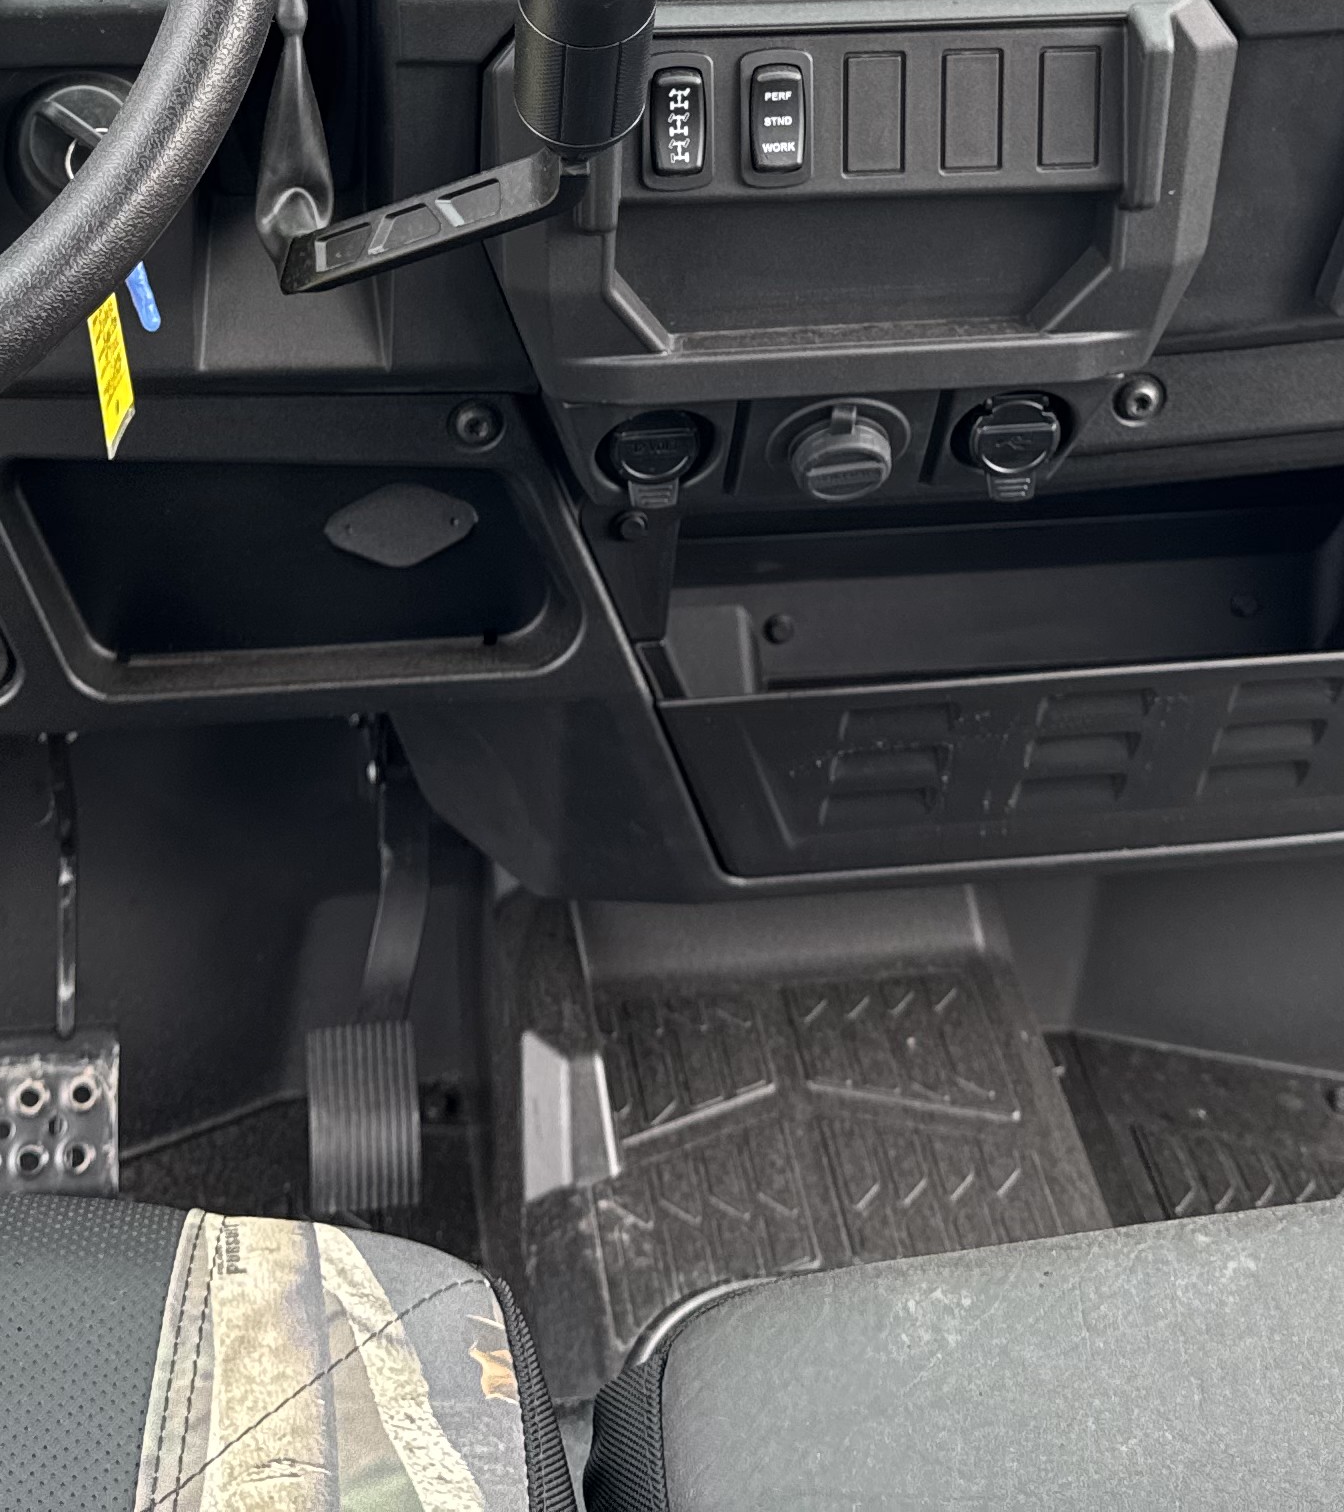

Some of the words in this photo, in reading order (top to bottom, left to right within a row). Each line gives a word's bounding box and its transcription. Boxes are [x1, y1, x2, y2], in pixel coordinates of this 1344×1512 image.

[764, 91, 792, 101] PERF
[763, 116, 793, 127] STND
[762, 141, 796, 153] WORK
[223, 1223, 247, 1275] PURSUIT
